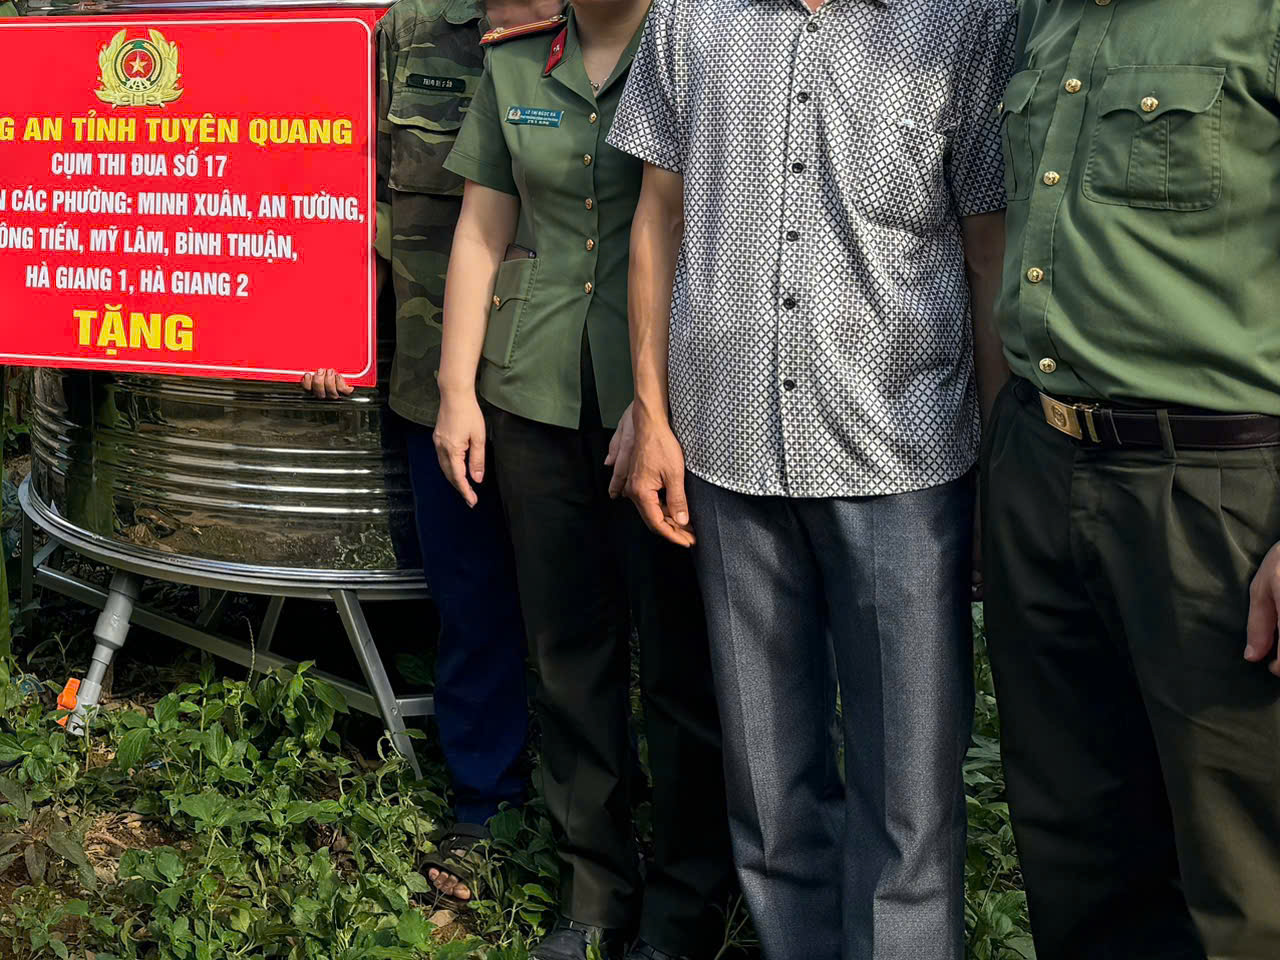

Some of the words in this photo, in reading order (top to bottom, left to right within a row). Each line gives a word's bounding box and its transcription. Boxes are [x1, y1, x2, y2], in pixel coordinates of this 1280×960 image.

[23, 117, 63, 141] AN
[71, 110, 137, 142] TỈNH
[145, 113, 239, 143] TUYÊN
[249, 118, 353, 147] QUANG
[51, 152, 93, 179] CỤM
[97, 154, 126, 176] THI
[131, 154, 168, 177] ĐUA
[173, 147, 200, 177] SỐ
[204, 155, 228, 178] 17
[11, 185, 47, 212] CÁC
[52, 186, 133, 214] PHƯỜNG:
[138, 192, 189, 216] MINH
[193, 189, 253, 220] XUÂN,
[257, 195, 287, 218] AN
[291, 191, 365, 223] TƯỜNG,
[38, 221, 84, 253] TIẾN,
[89, 225, 119, 252] MỸ
[123, 226, 170, 256] LÂM,
[175, 227, 222, 257] BÌNH
[226, 230, 298, 263] THUẬN,
[25, 261, 51, 289] HÀ
[55, 266, 113, 291] GIANG
[117, 269, 135, 295] 1,
[139, 265, 166, 294] HÀ
[171, 271, 231, 296] GIANG
[235, 274, 249, 297] 2
[72, 304, 194, 355] TẶNG
